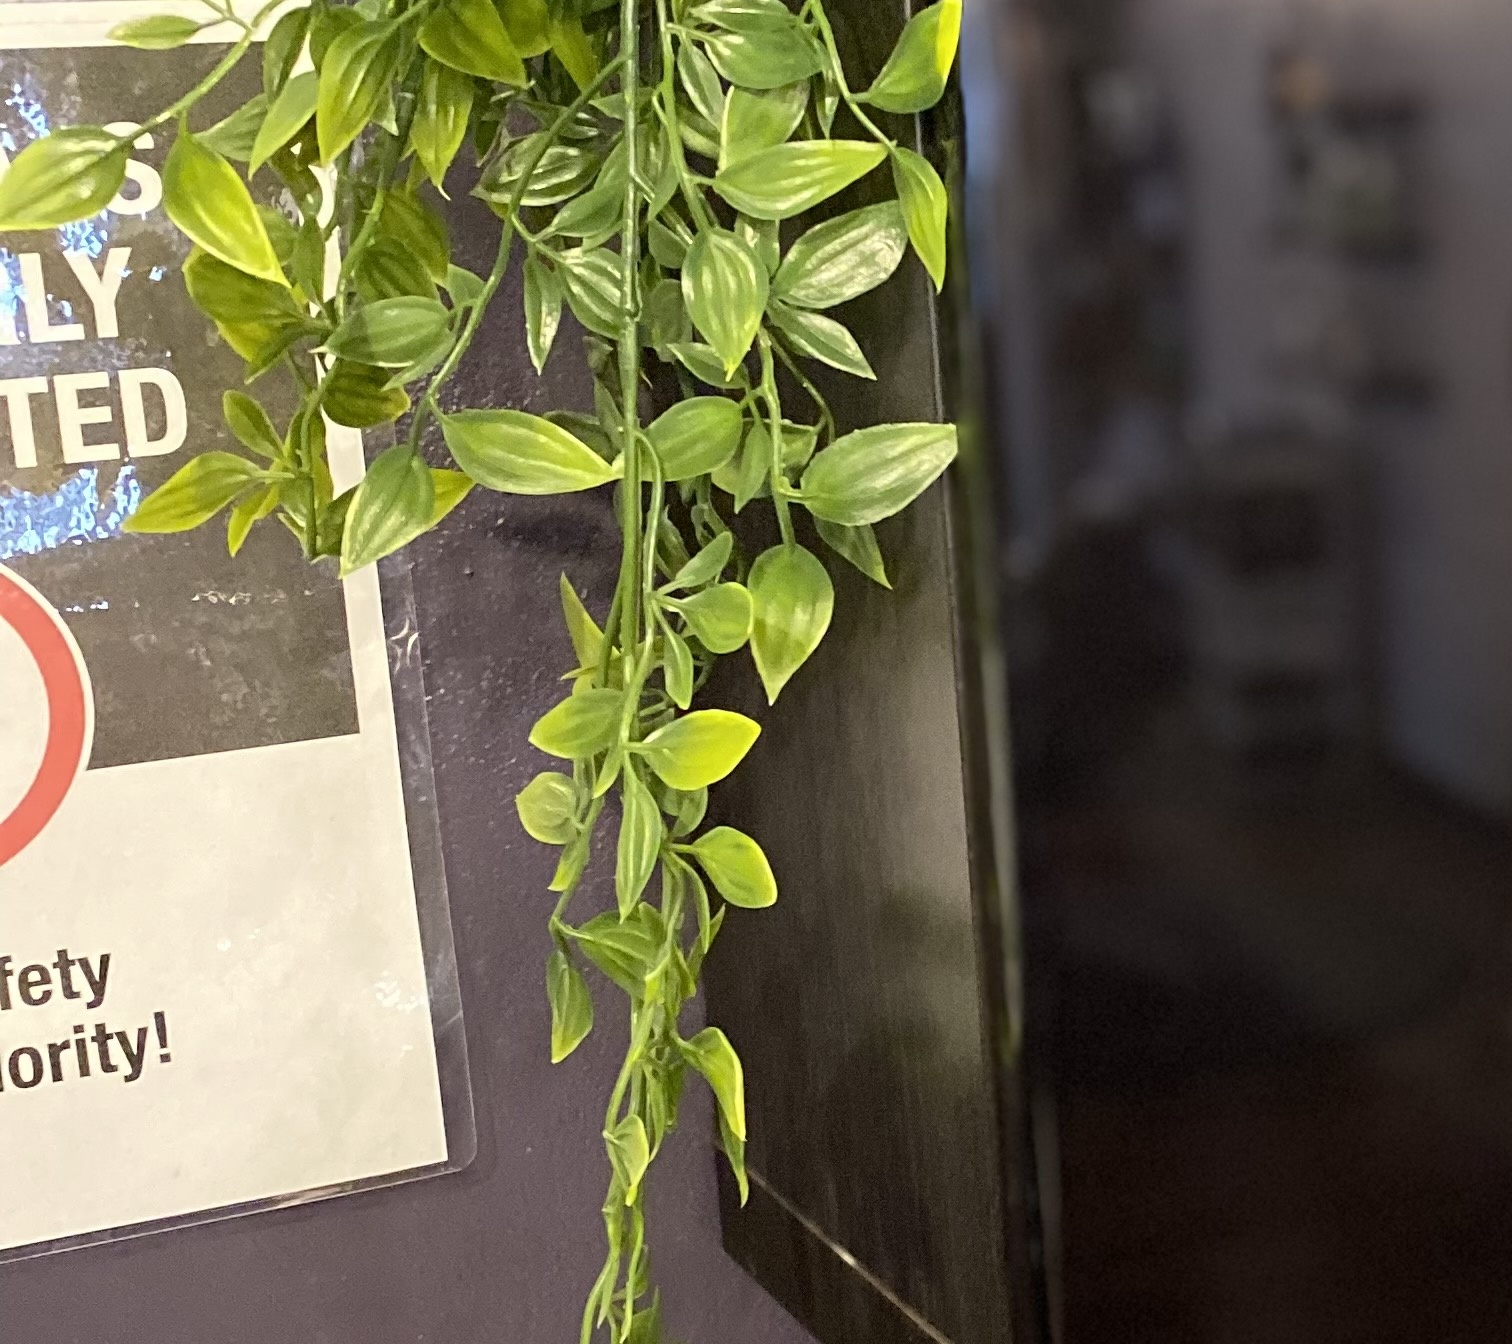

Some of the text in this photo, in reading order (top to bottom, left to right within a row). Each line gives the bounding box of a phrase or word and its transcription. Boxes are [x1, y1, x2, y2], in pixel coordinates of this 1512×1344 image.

[0, 246, 133, 345] LY
[0, 366, 188, 469] TED
[0, 1010, 172, 1093] ority!
